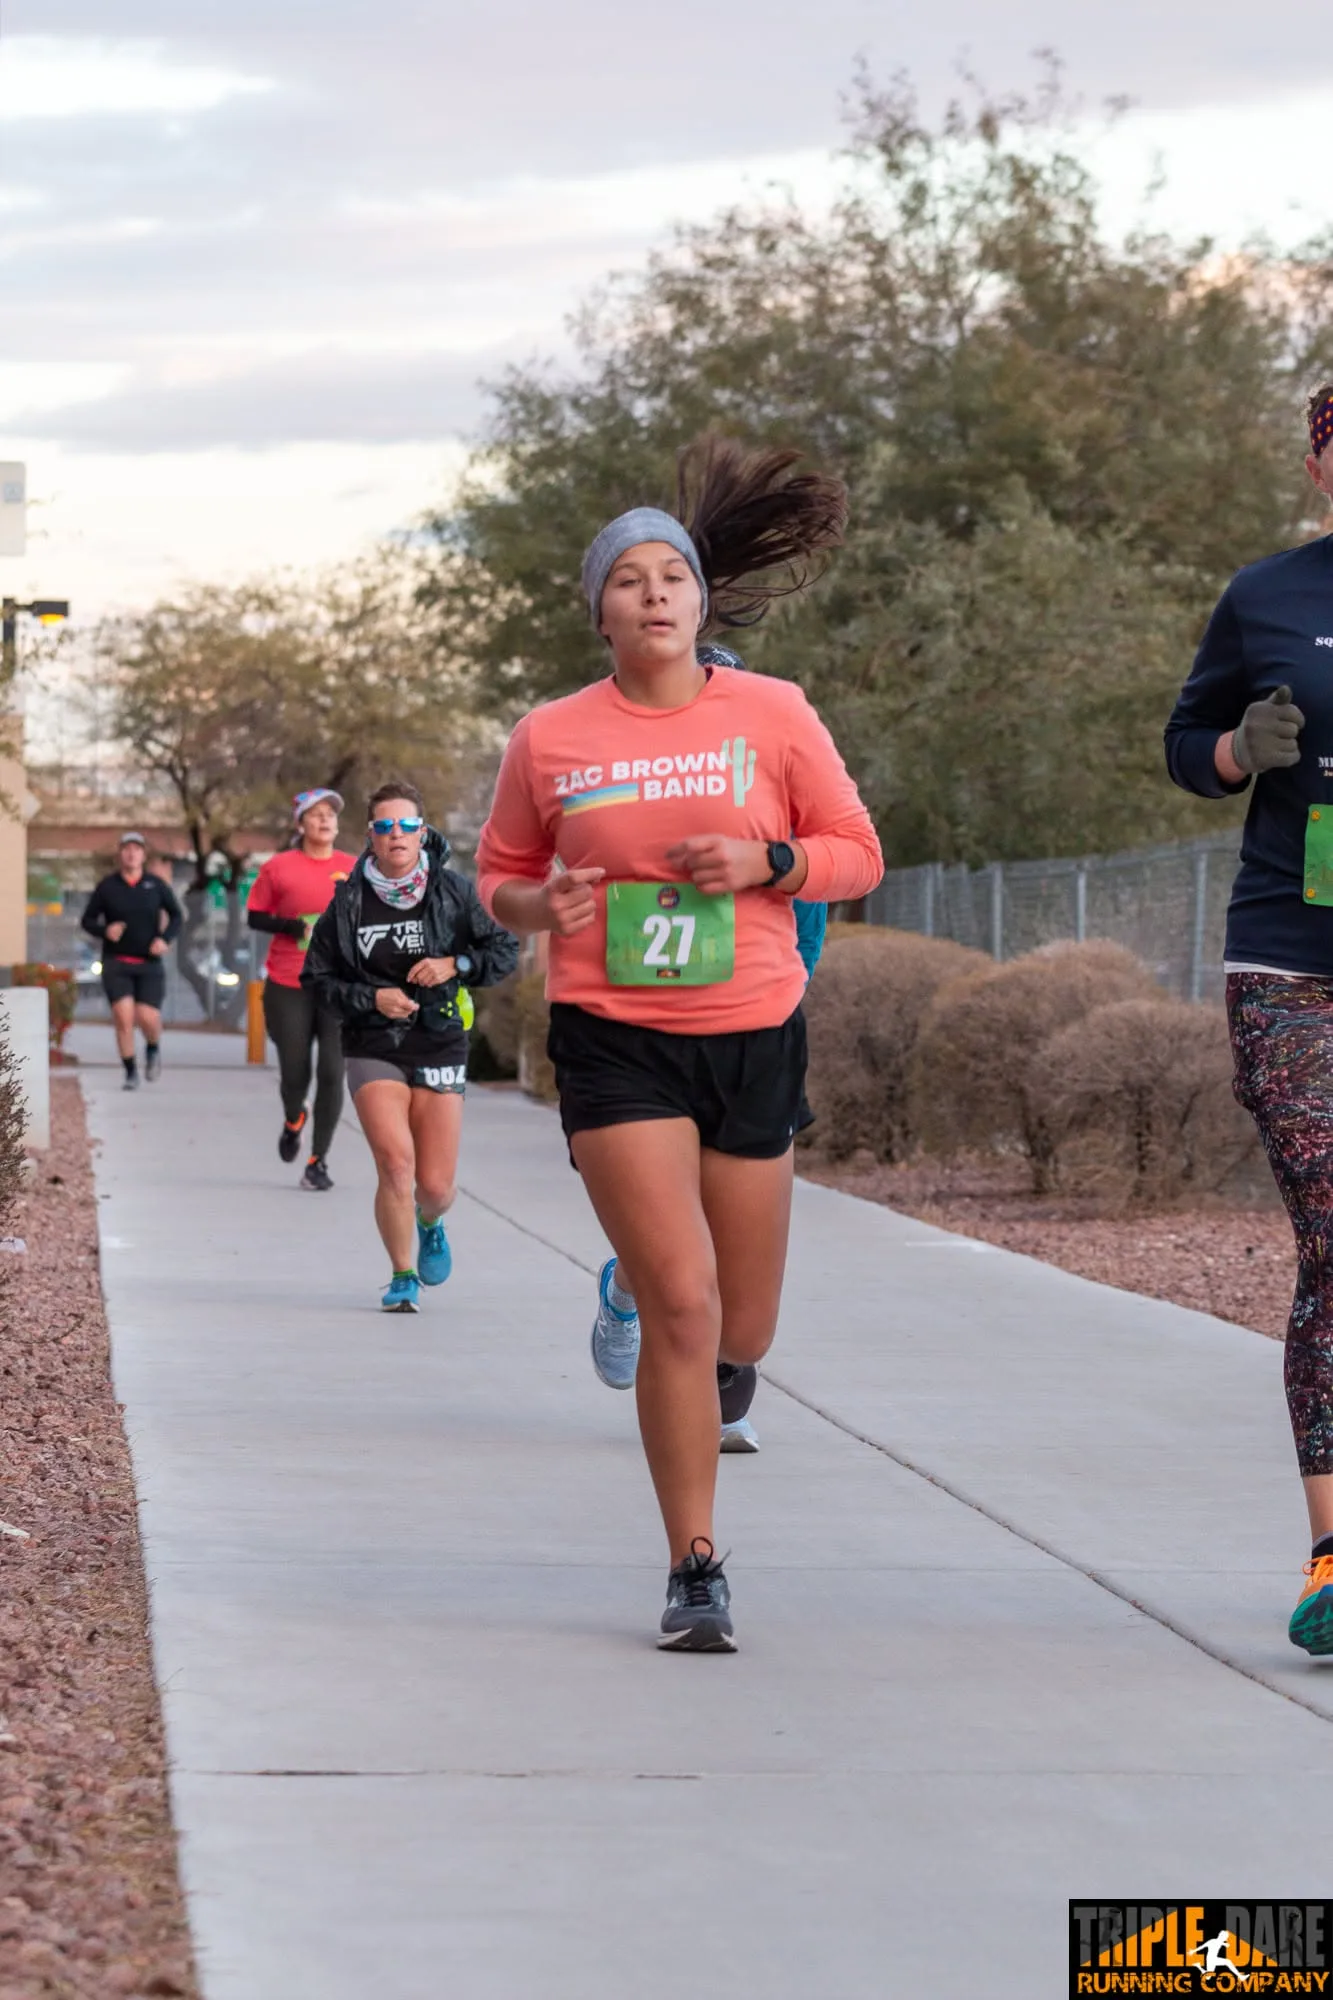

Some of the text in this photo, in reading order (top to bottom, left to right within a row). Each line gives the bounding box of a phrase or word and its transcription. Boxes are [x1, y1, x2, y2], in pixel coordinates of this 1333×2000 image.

[553, 751, 727, 796] ZAC BROWN
[644, 775, 727, 801] BAND
[643, 914, 696, 967] 27
